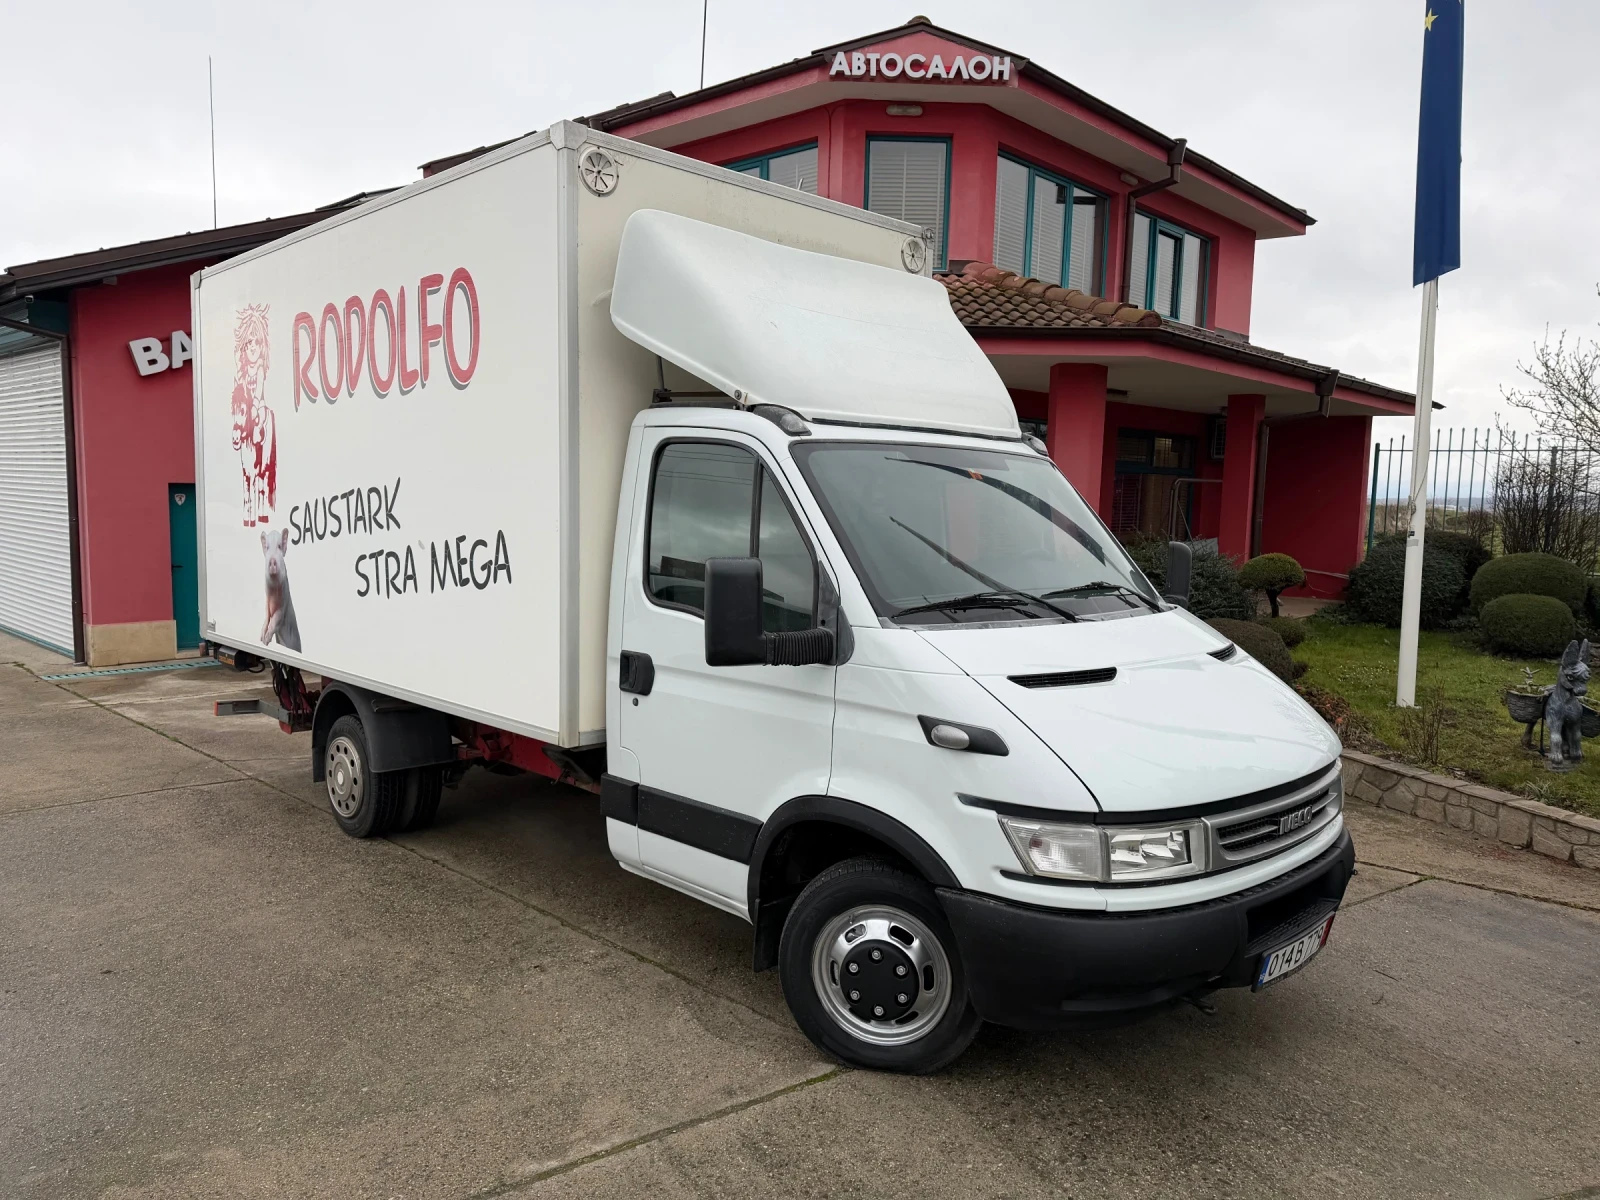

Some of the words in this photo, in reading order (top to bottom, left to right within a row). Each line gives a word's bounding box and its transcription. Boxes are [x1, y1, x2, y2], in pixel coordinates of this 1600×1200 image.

[829, 51, 1011, 81] АВТОСАЛОН
[292, 267, 480, 412] RODOLFO
[289, 477, 401, 545] SAUSTARK
[355, 545, 418, 600] STRA
[430, 529, 512, 594] MEGA
[1279, 805, 1313, 835] IVECO
